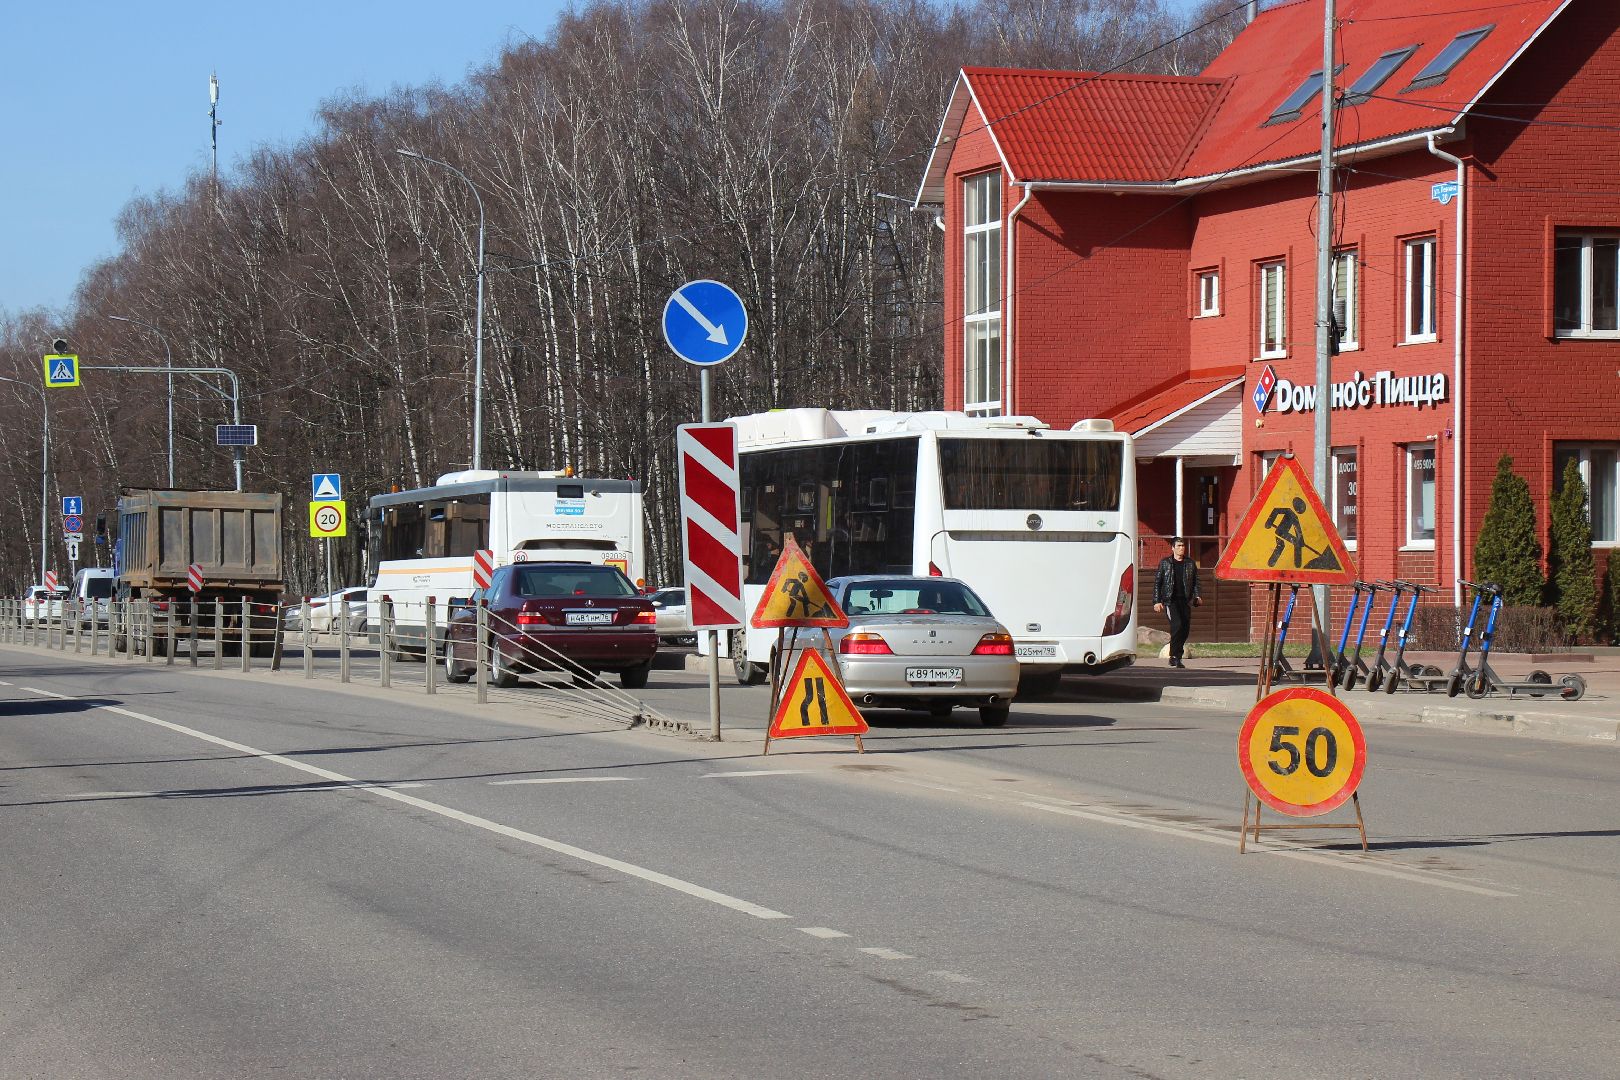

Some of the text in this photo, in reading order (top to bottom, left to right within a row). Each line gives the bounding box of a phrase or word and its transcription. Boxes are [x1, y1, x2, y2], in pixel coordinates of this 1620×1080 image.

[1277, 370, 1445, 412] Dомно'с Пицца
[321, 514, 336, 525] 20
[516, 552, 526, 561] 60
[1267, 725, 1337, 778] 50
